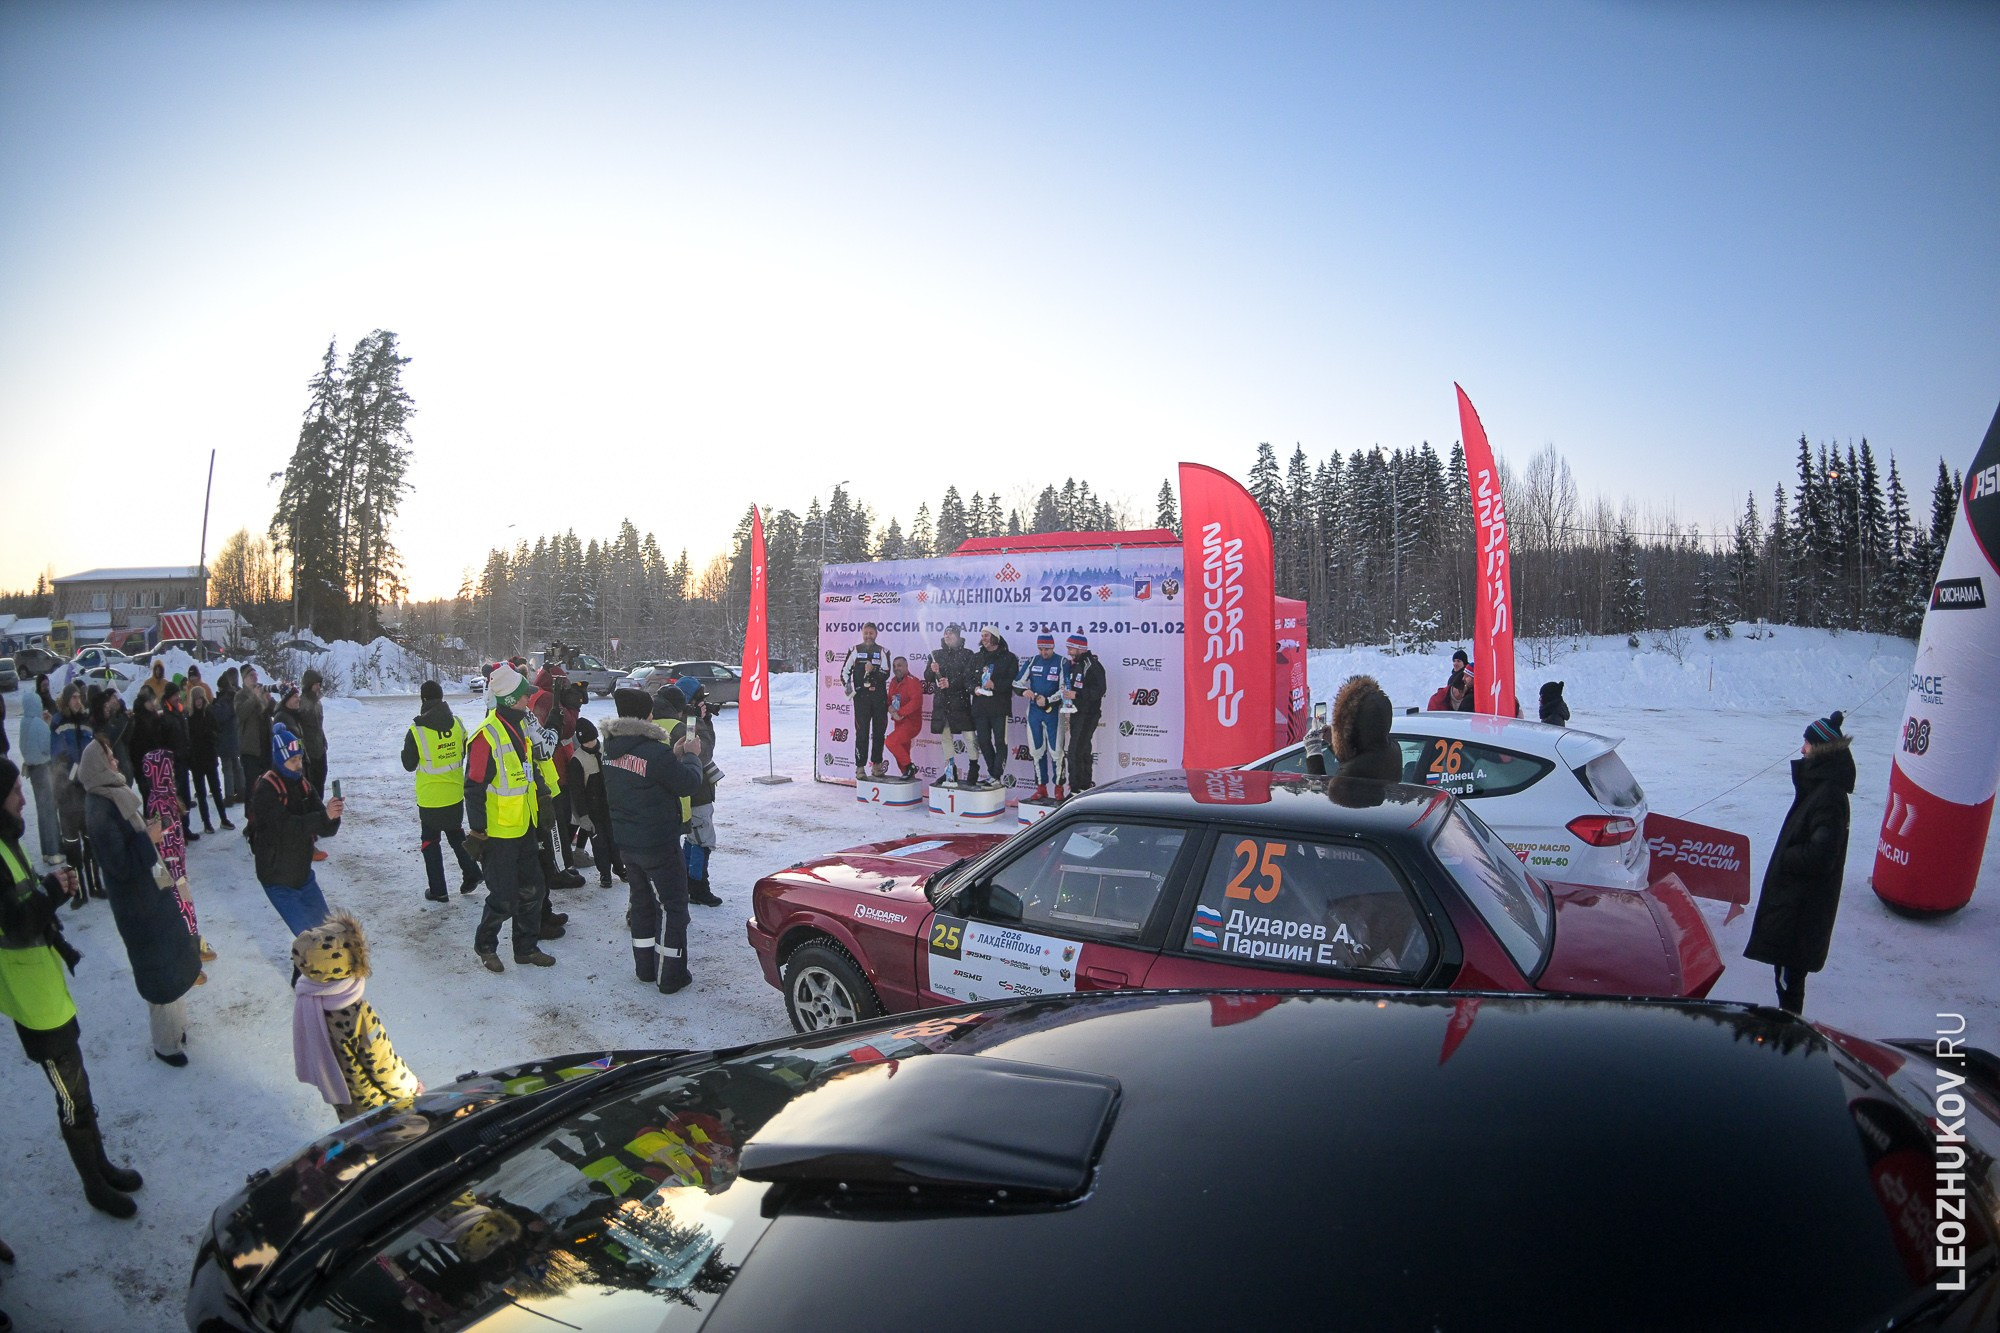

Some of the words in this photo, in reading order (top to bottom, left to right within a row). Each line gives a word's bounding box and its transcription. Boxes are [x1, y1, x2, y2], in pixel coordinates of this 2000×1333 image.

[930, 587, 1031, 605] ЛАХДЕНПОХЬЯ
[1040, 585, 1092, 602] 2026
[1939, 586, 1981, 602] YOKOHAMA
[875, 622, 920, 633] ОССИИ
[925, 622, 944, 633] ПО
[1015, 622, 1024, 633] 2
[1029, 622, 1071, 633] ЭТАП
[1122, 657, 1162, 668] SPACE
[1132, 688, 1160, 706] R8
[1920, 694, 1944, 705] TRAVEL
[825, 703, 851, 711] SPACE
[1903, 715, 1931, 756] R8
[1429, 739, 1464, 775] 26
[1440, 771, 1475, 784] Донец
[1476, 768, 1487, 779] А.
[871, 787, 880, 803] 2
[948, 794, 955, 813] 1
[1538, 844, 1571, 853] МАСЛО
[1679, 839, 1735, 857] РАЛЛИ
[1674, 851, 1740, 872] РОССИИ
[1225, 839, 1287, 904] 25
[866, 907, 908, 923] DUDAREV
[1225, 908, 1327, 941] Дударев
[1332, 922, 1356, 945] А.
[932, 923, 960, 951] 25
[1001, 930, 1022, 941] 2026
[977, 933, 1042, 956] ЛАХДЕНПОХЬЯ
[1222, 932, 1312, 962] Паршин
[967, 951, 993, 961] RSMG
[956, 970, 983, 982] RSMG
[1014, 983, 1043, 994] РАЛЛИ
